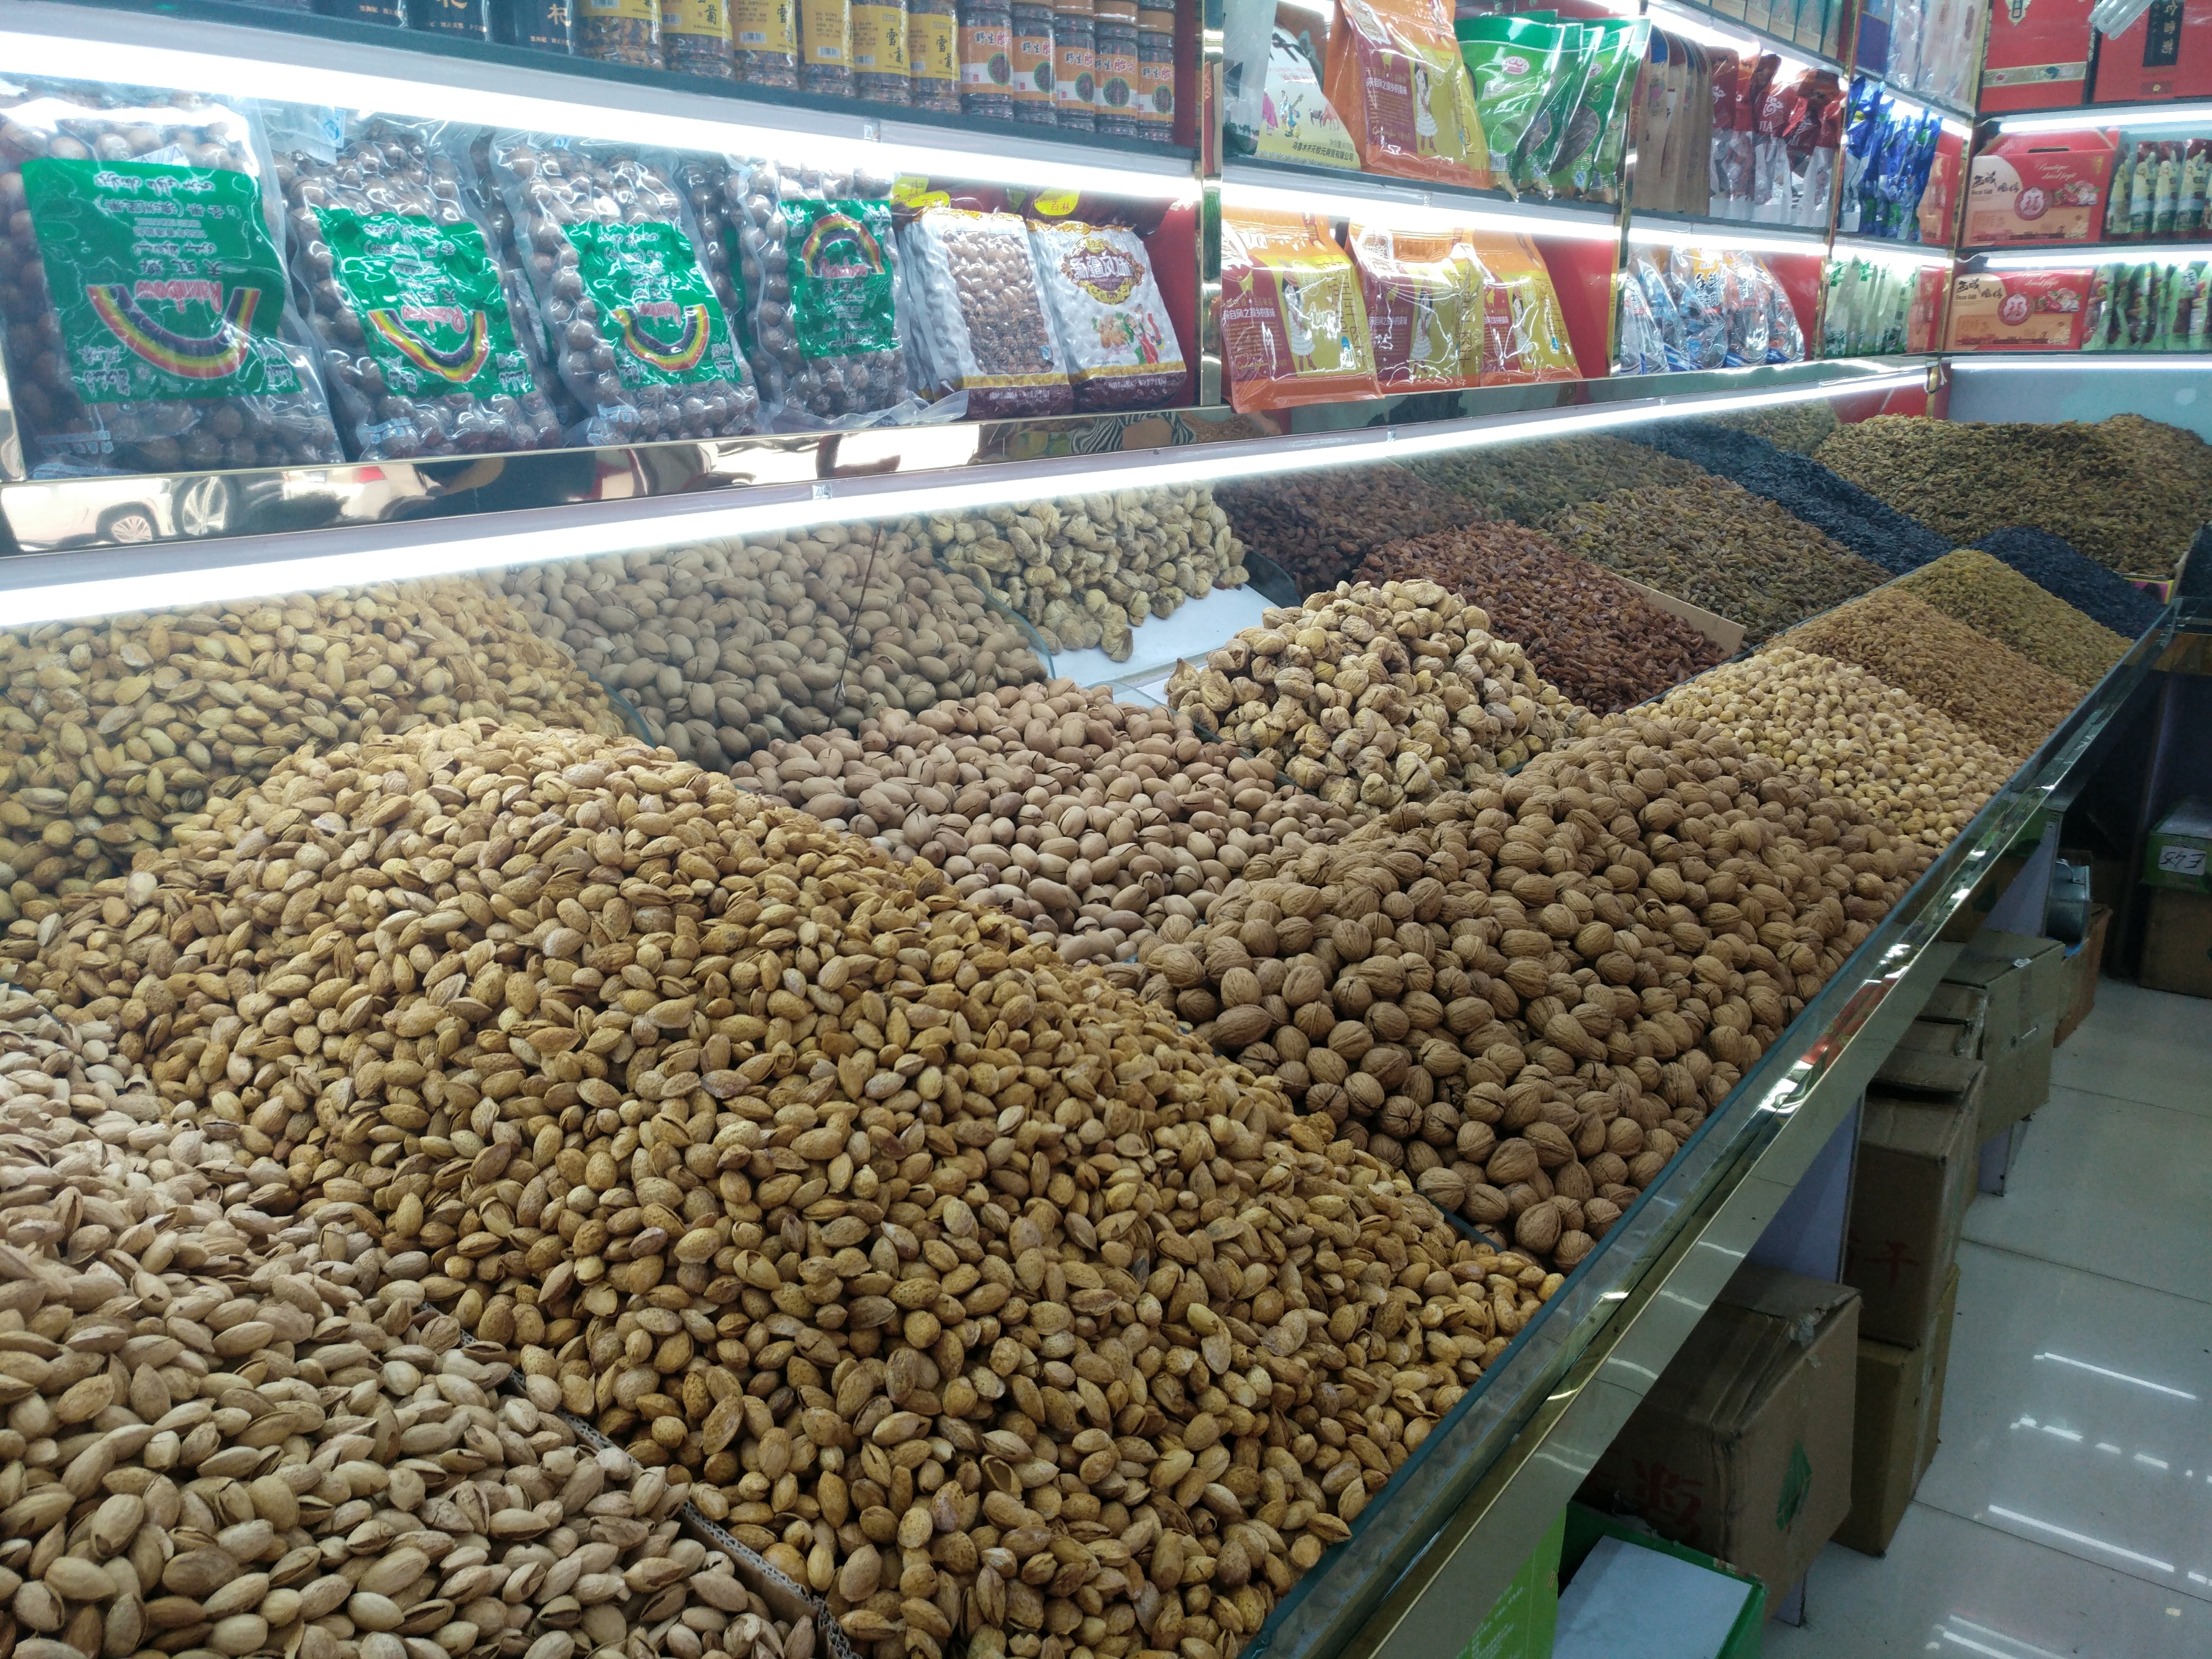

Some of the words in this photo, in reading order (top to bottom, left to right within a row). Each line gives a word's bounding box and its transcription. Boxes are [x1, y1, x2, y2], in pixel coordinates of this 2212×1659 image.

[974, 30, 1013, 46] 野生胎
[1021, 40, 1055, 56] 野生胎
